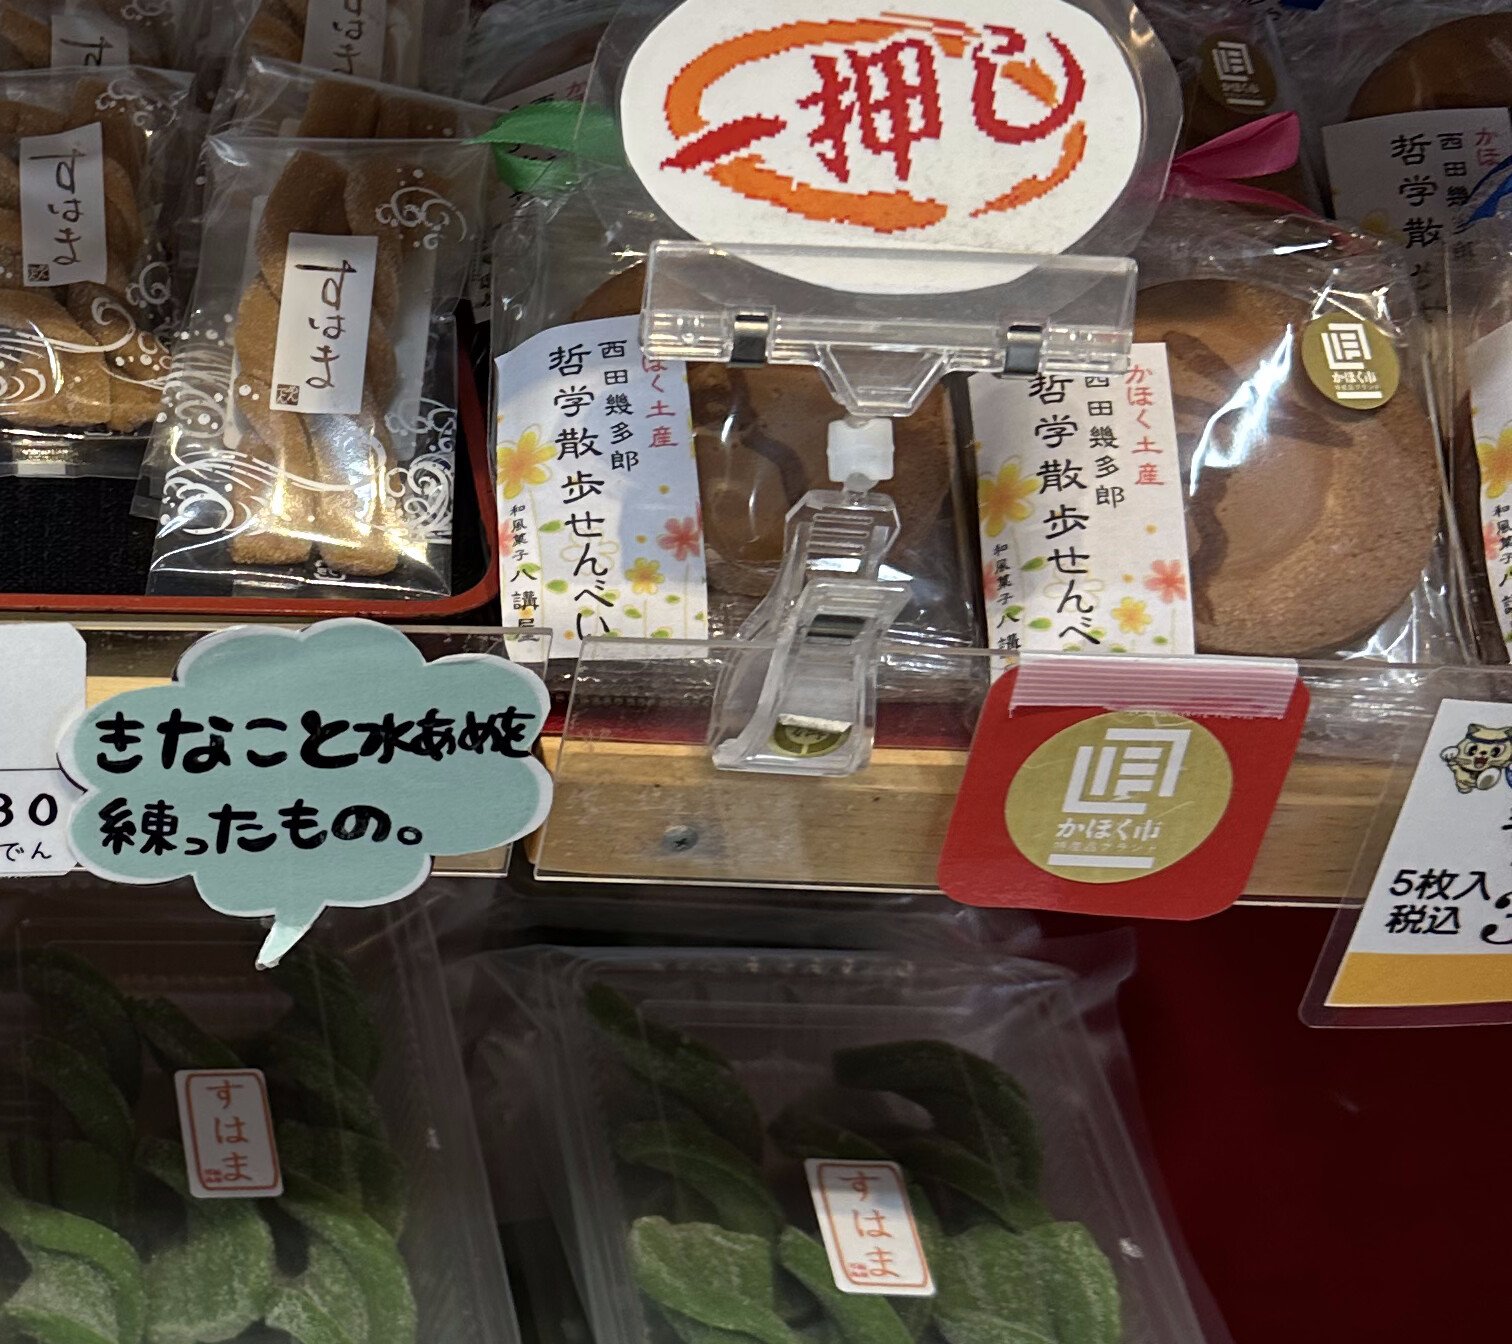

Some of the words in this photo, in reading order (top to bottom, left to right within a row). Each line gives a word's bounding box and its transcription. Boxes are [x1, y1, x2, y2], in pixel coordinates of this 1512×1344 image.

[29, 149, 84, 267] すはま
[295, 258, 357, 390] すはま
[598, 340, 640, 472] 西田幾多郎
[642, 356, 678, 449] ほく土産
[1125, 364, 1165, 486] かほく土産
[549, 343, 614, 640] 哲学散歩せんべい
[1028, 374, 1101, 645] 哲学散歩せんべ
[95, 706, 536, 774] きなこと水あめを
[98, 797, 423, 857] 練ったもの。
[1056, 817, 1163, 842] かほく市
[1385, 904, 1461, 934] 税込
[1390, 868, 1491, 901] 5枚入
[205, 1079, 254, 1183] すはま
[840, 1170, 901, 1279] すはま
